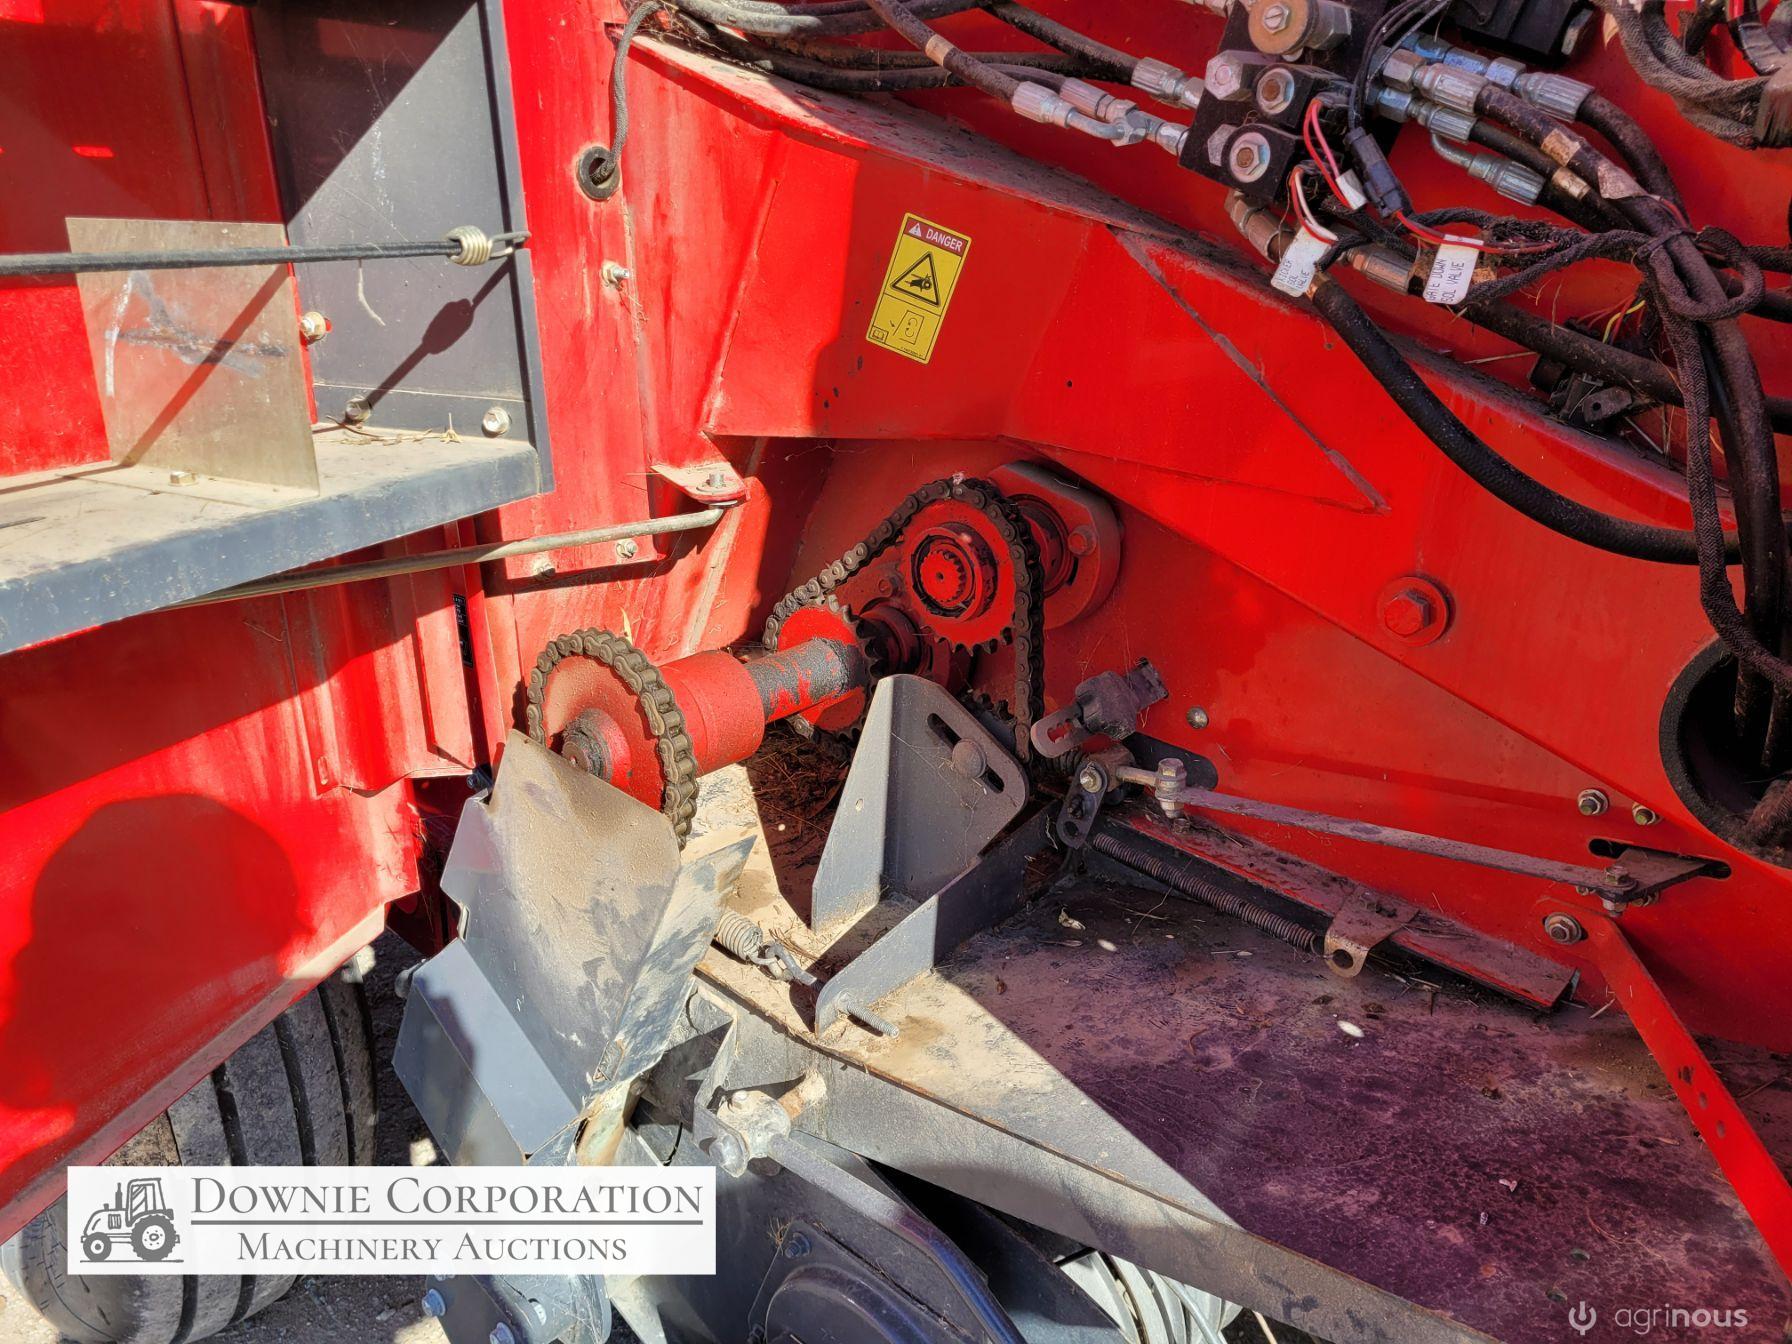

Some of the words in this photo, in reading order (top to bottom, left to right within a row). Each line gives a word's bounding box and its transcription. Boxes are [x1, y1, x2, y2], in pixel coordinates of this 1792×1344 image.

[926, 228, 963, 252] DANGER
[1431, 258, 1447, 279] DOWN
[1446, 261, 1465, 285] VALVE
[1425, 283, 1440, 300] GATE
[1440, 289, 1456, 302] SOL
